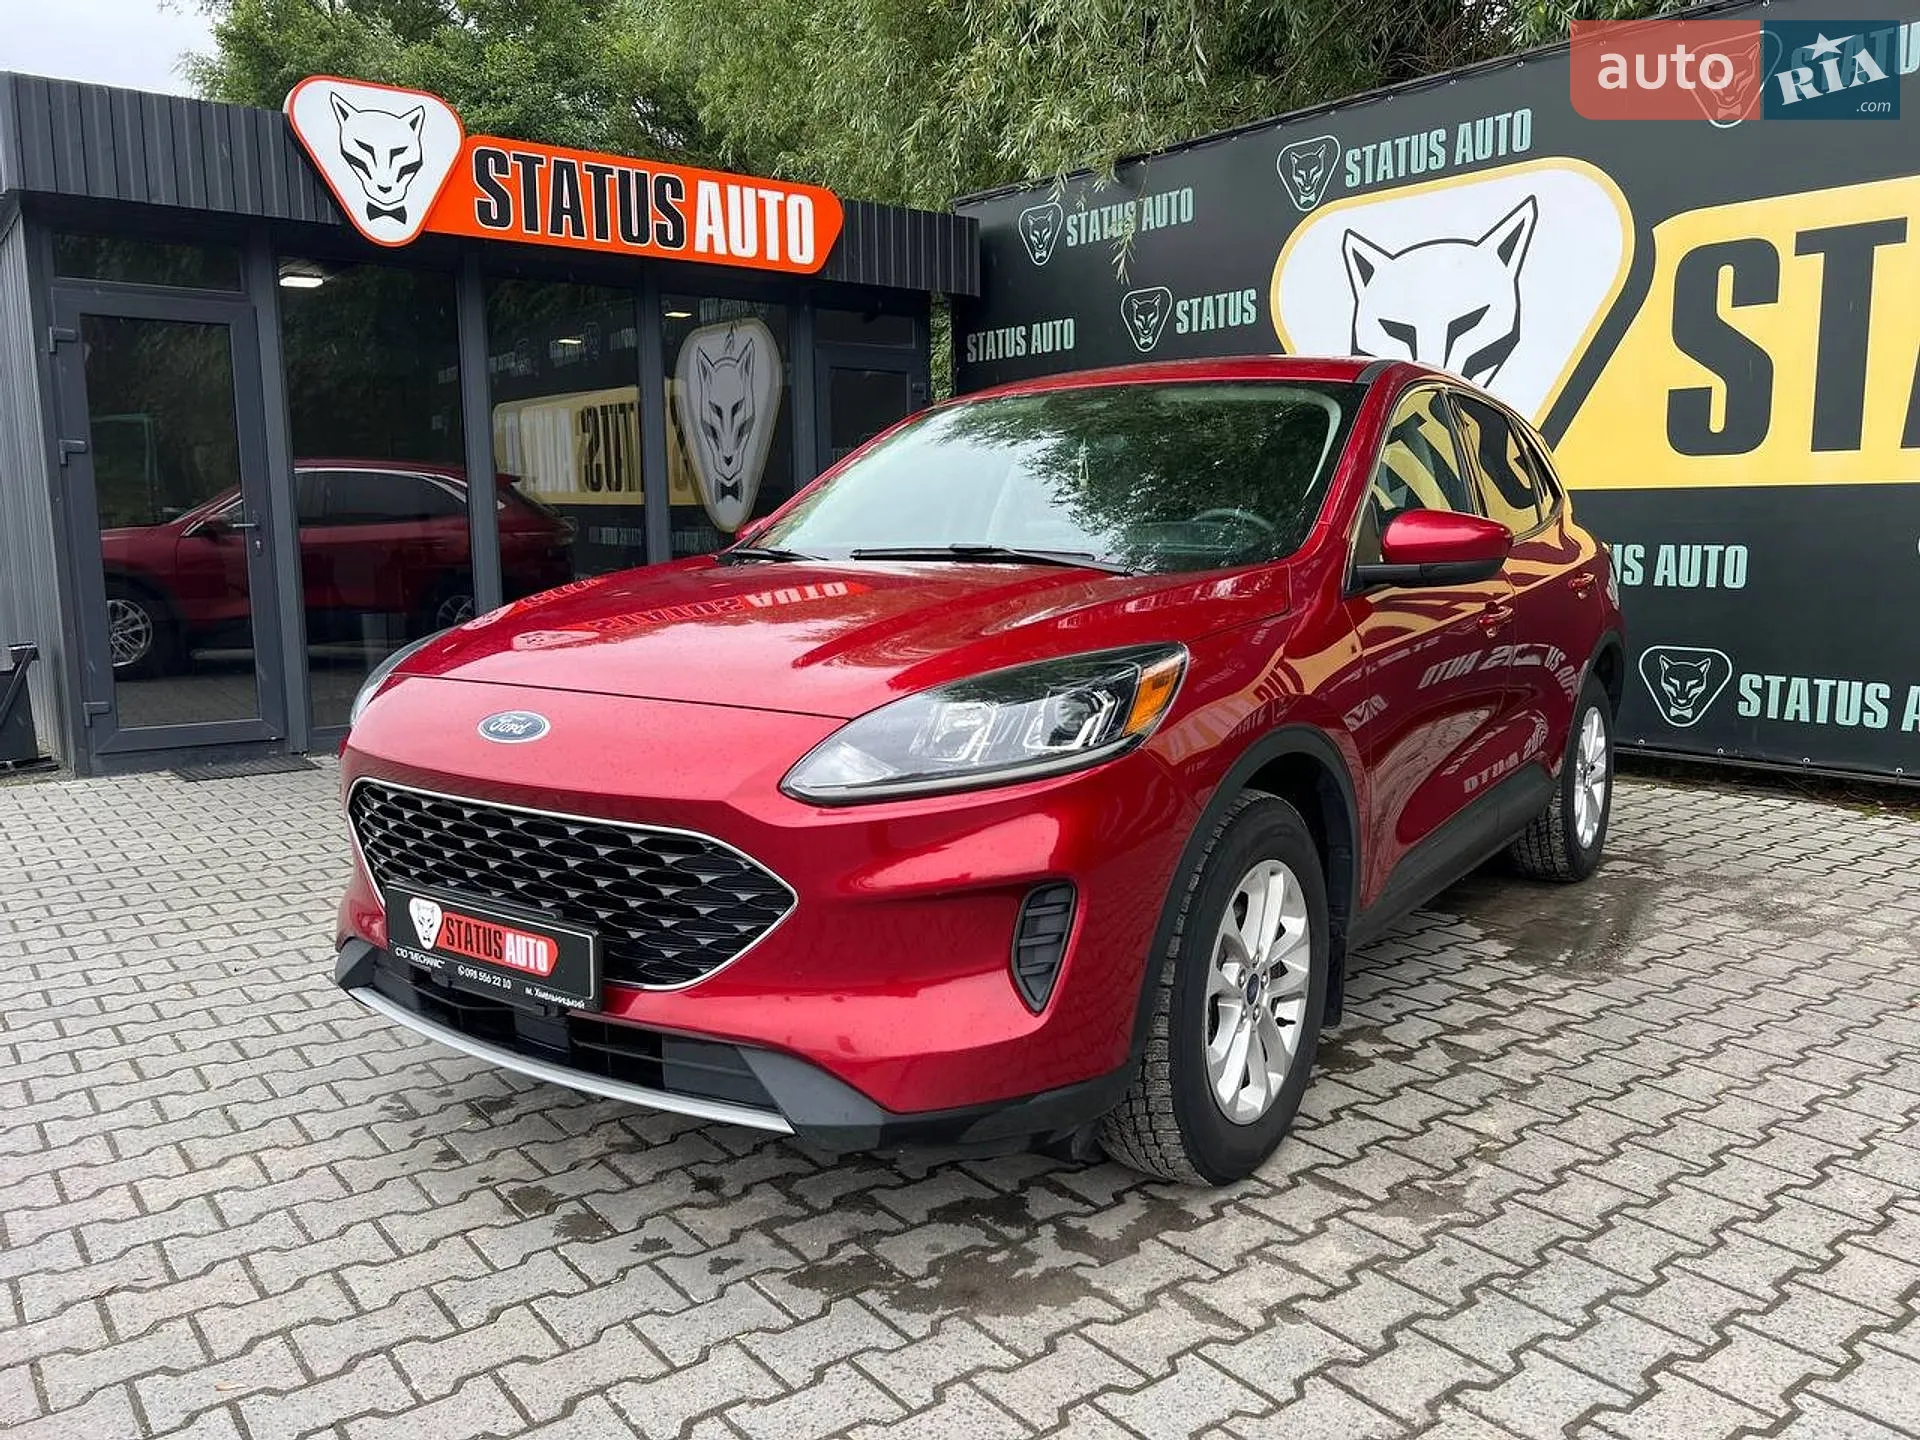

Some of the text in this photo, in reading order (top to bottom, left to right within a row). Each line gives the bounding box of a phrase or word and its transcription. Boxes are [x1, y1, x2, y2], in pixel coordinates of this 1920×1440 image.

[1345, 108, 1532, 188] STATUS AUTO
[472, 147, 815, 265] STATUS AUTO
[1141, 187, 1193, 231] AUTO
[1176, 289, 1258, 334] STATUS
[1666, 217, 1920, 457] ST
[966, 318, 1076, 363] STATUS AUTO
[1653, 544, 1749, 589] AUTO
[1737, 673, 1891, 729] STATUS
[445, 917, 548, 973] STATUS AUTO
